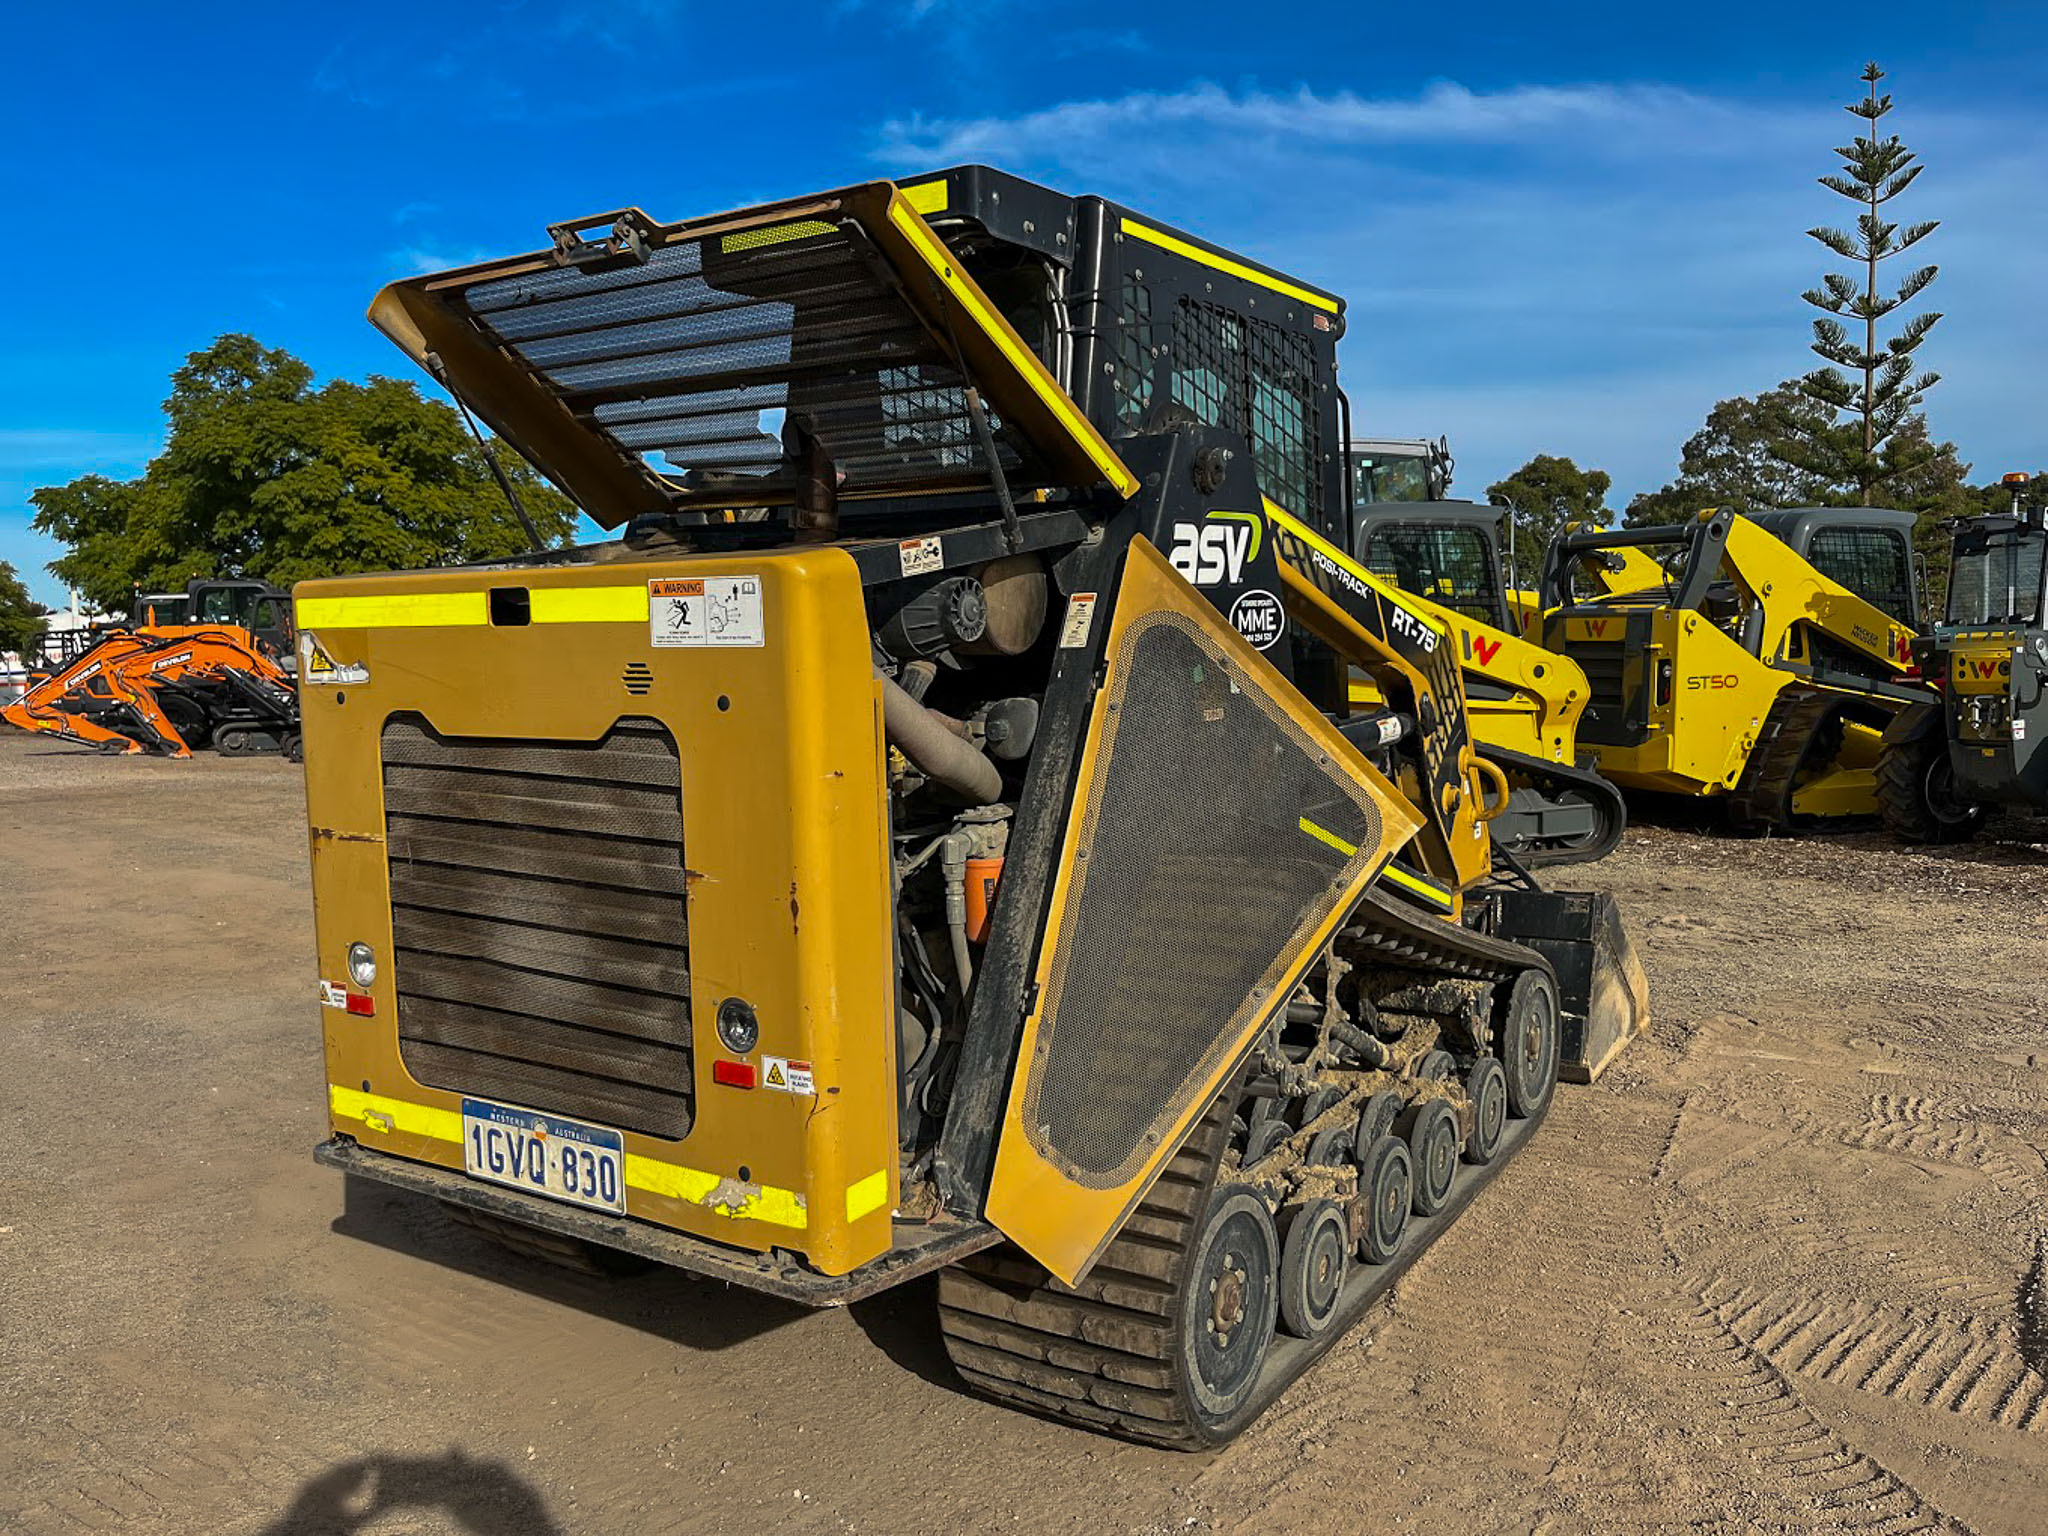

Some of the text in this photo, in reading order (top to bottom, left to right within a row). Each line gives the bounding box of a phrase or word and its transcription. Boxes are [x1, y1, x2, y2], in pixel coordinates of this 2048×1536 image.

[664, 582, 702, 594] WARNING
[1312, 550, 1369, 599] POSI-TRACK
[1237, 608, 1277, 632] MME
[1391, 606, 1436, 654] RT-75
[1687, 674, 1739, 690] ST50
[489, 1112, 592, 1143] WESTERN AUSTRALIA
